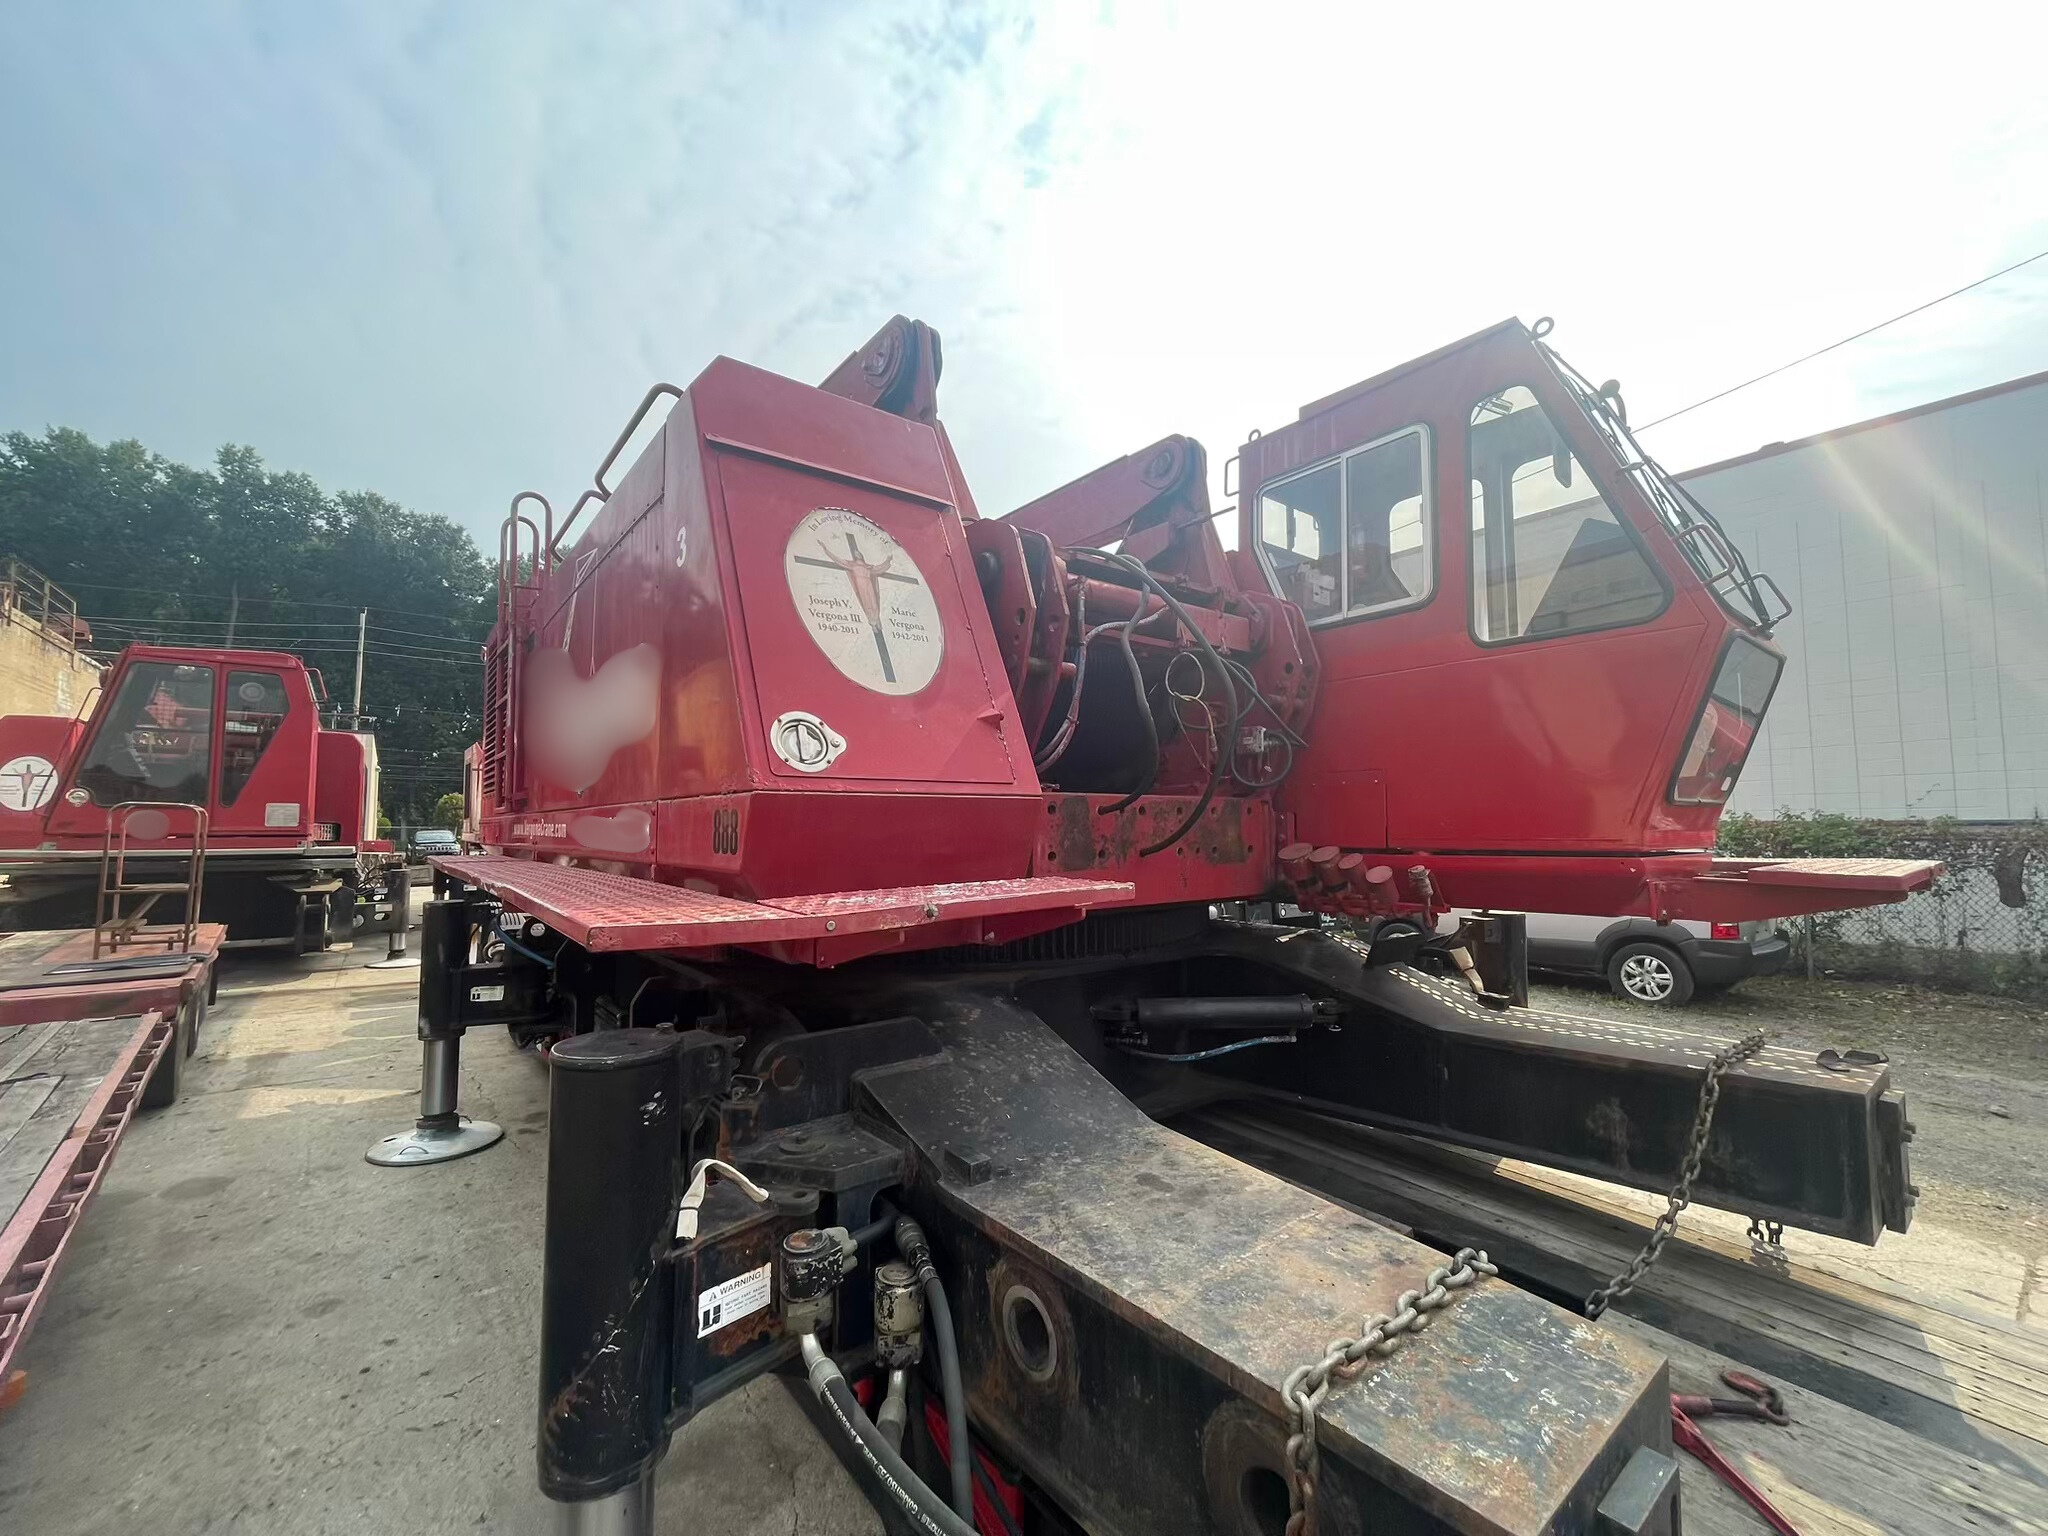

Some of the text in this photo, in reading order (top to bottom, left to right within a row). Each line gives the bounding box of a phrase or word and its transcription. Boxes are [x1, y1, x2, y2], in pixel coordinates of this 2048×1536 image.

[807, 523, 819, 532] In
[814, 513, 844, 526] Loving
[844, 514, 879, 536] Memory
[676, 526, 687, 568] 3
[808, 594, 852, 609] Joseph V.
[808, 607, 861, 623] Vergona III
[890, 606, 917, 618] Marie
[888, 617, 925, 632] Vergona
[719, 1271, 761, 1295] WARNING
